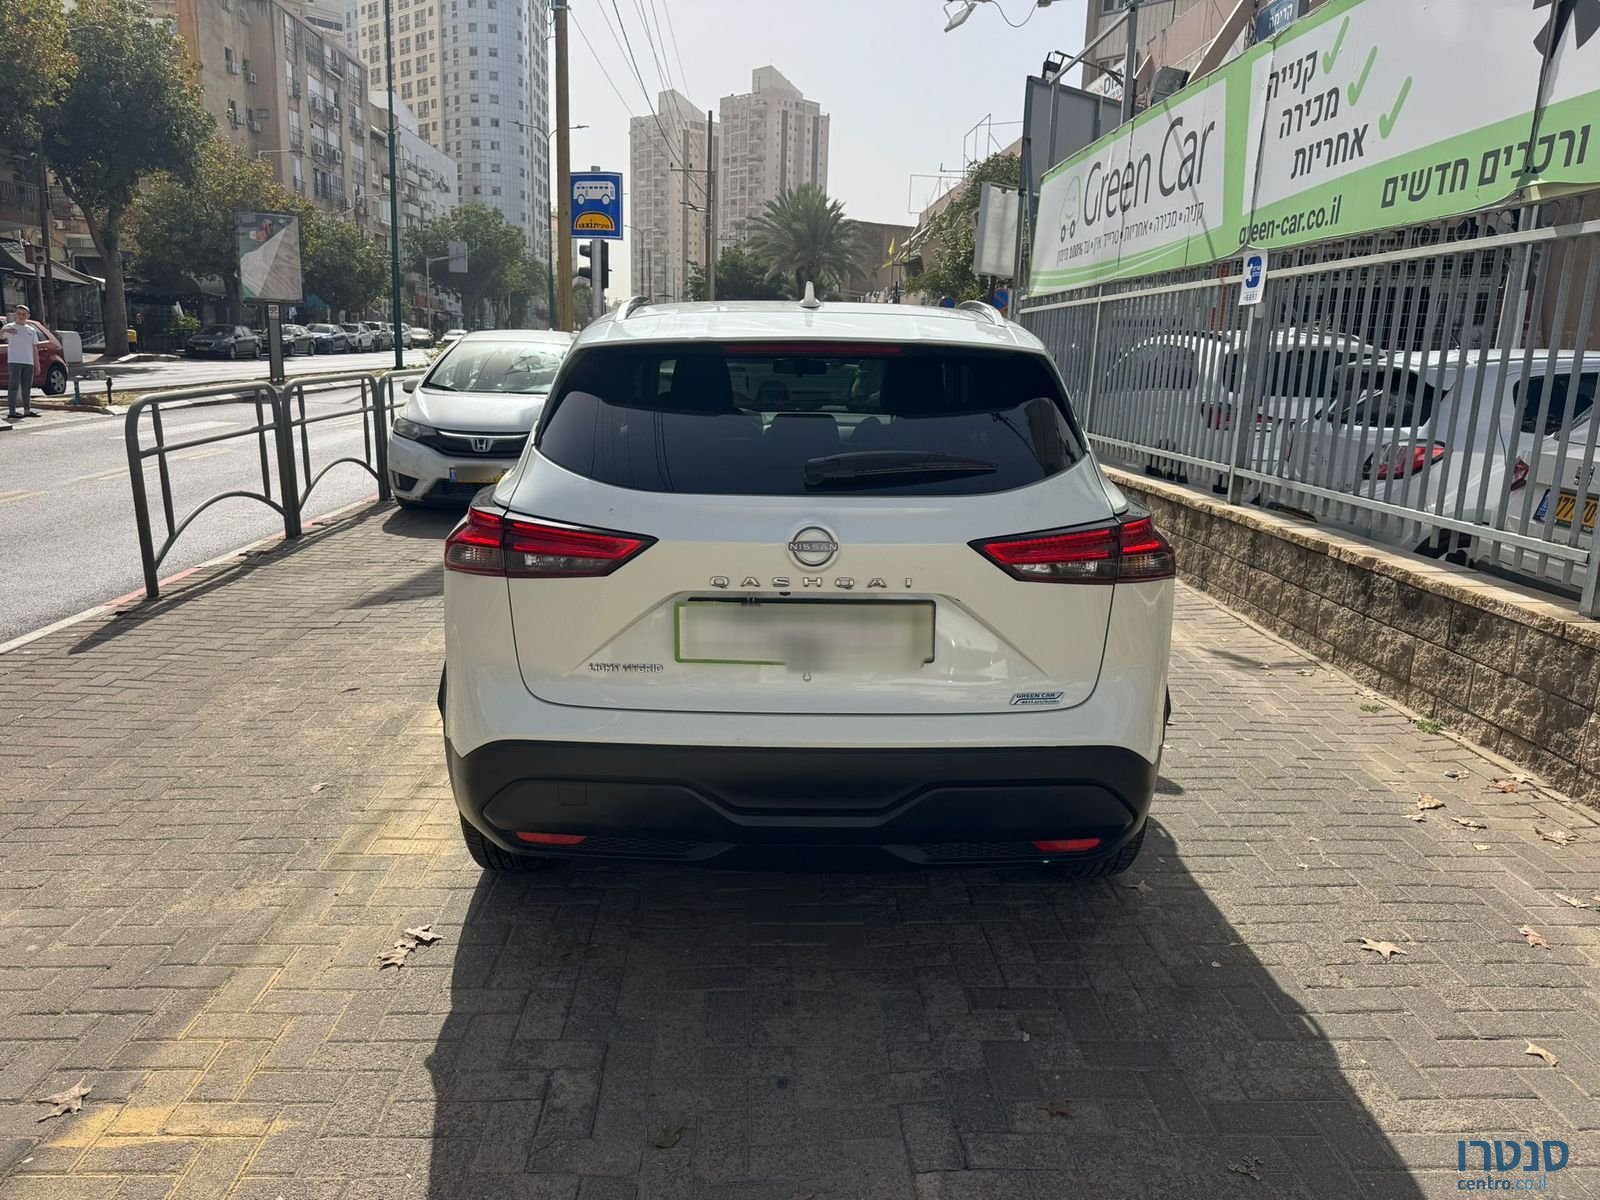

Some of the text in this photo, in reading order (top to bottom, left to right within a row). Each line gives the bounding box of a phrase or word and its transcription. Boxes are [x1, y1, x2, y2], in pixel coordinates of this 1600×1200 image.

[1266, 50, 1318, 101] קנייה
[1279, 87, 1340, 139] מכירה
[1290, 123, 1369, 180] אחריות
[1381, 124, 1591, 209] ורכבים חדשים
[1083, 116, 1216, 227] Green Car
[1123, 219, 1149, 242] אחריות
[1153, 211, 1177, 233] מכירה
[1184, 202, 1204, 226] קניה
[789, 542, 838, 551] NISSAN
[709, 575, 913, 589] QASHQAI
